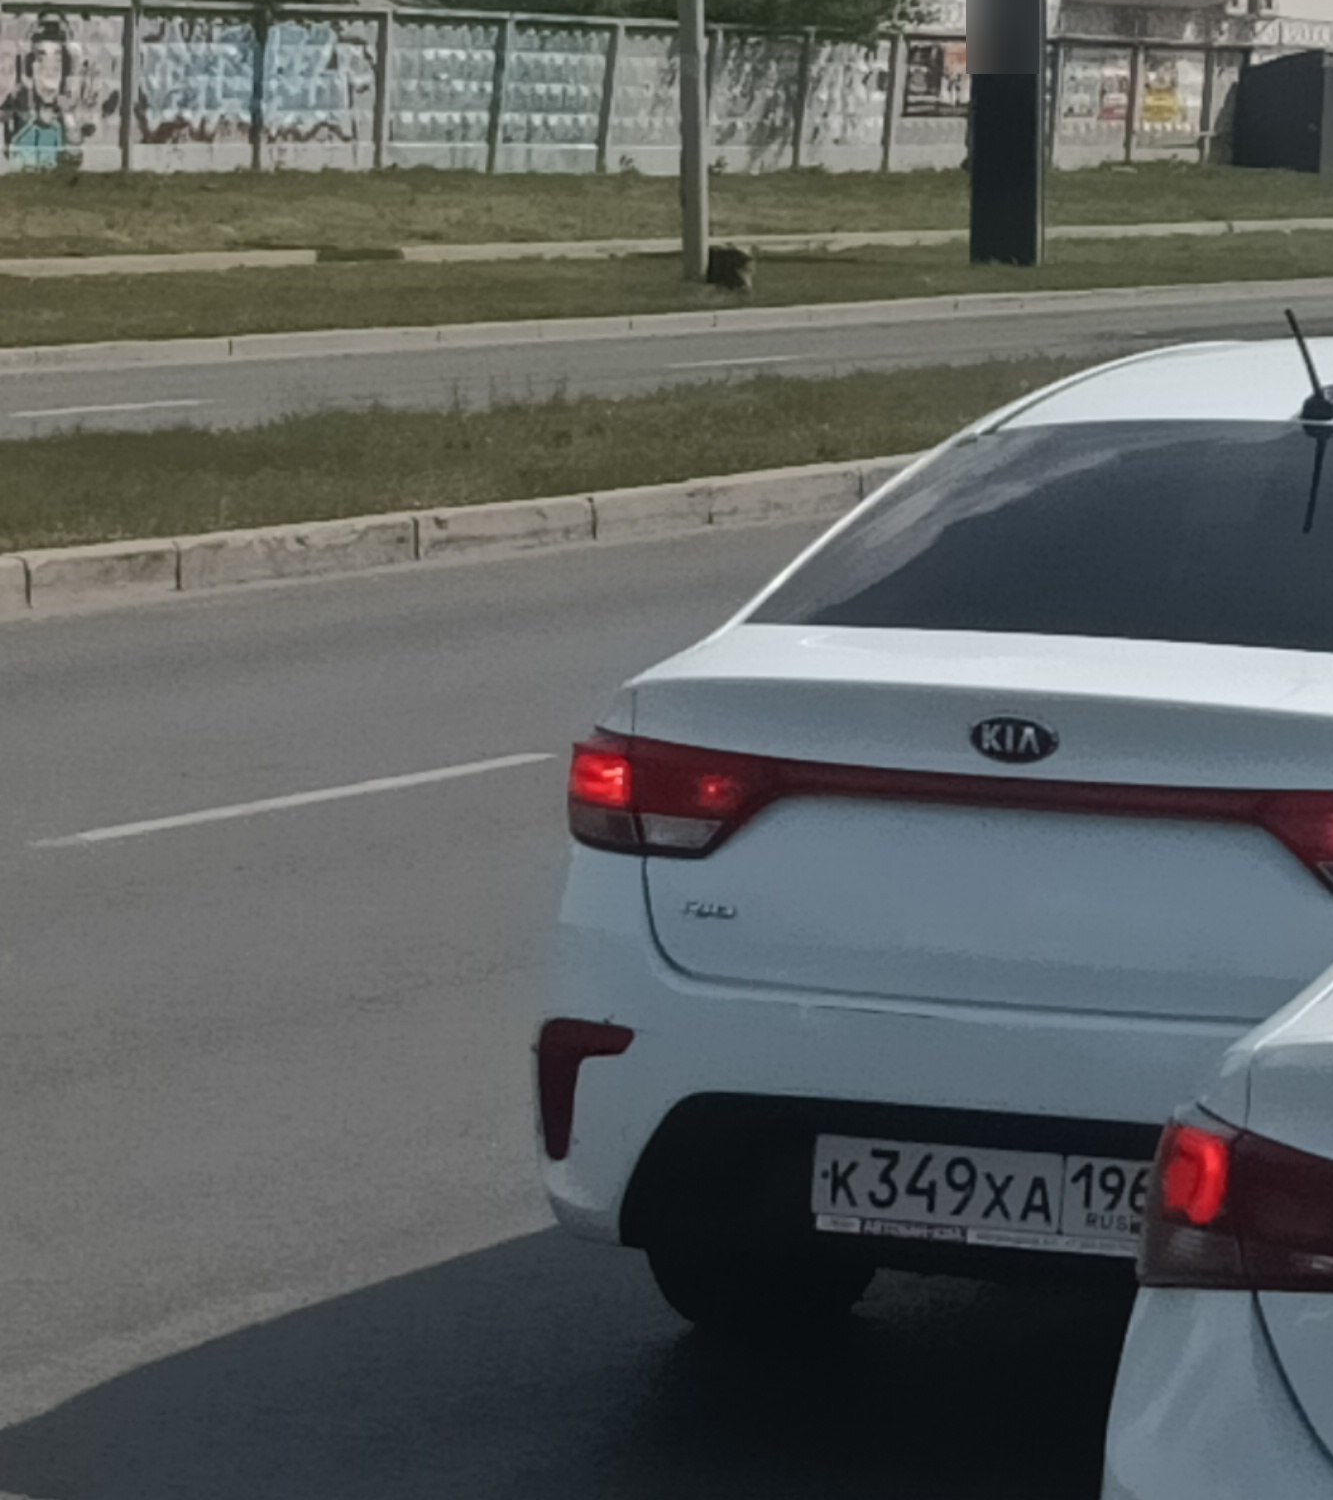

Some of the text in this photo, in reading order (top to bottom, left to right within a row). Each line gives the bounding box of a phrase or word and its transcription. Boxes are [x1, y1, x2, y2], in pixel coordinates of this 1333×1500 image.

[982, 723, 1040, 754] KIA
[829, 1148, 1052, 1225] К349ХА
[1085, 1212, 1129, 1231] RUS
